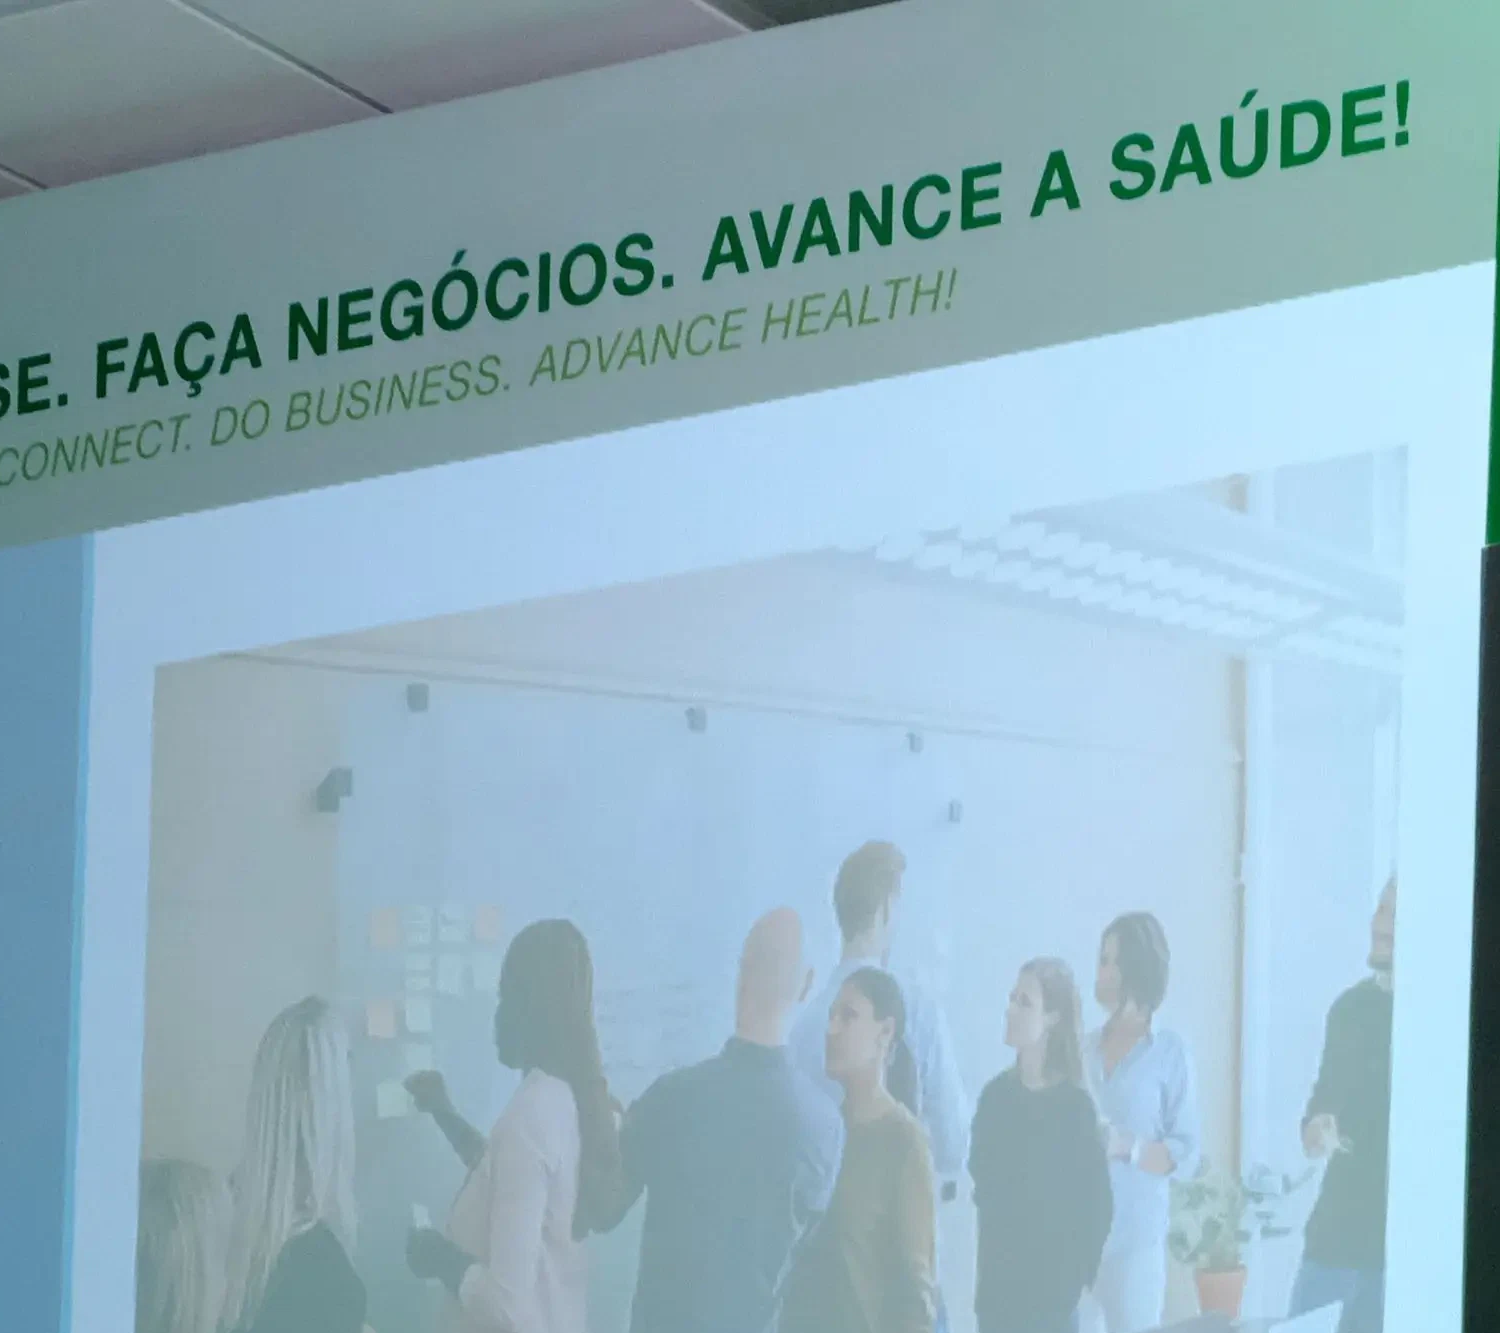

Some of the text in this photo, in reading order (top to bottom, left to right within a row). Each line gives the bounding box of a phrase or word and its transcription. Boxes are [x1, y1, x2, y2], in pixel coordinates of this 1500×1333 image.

[96, 313, 262, 399] FAÇA
[288, 232, 675, 362] NEGÓCIOS.
[702, 161, 1002, 282] AVANCE
[1029, 149, 1082, 218] A
[1109, 79, 1410, 202] SAÚDE!
[209, 399, 270, 447] DO
[285, 354, 511, 434] BUSINESS.
[528, 306, 747, 388] ADVANCE
[760, 267, 958, 345] HEALTH!
